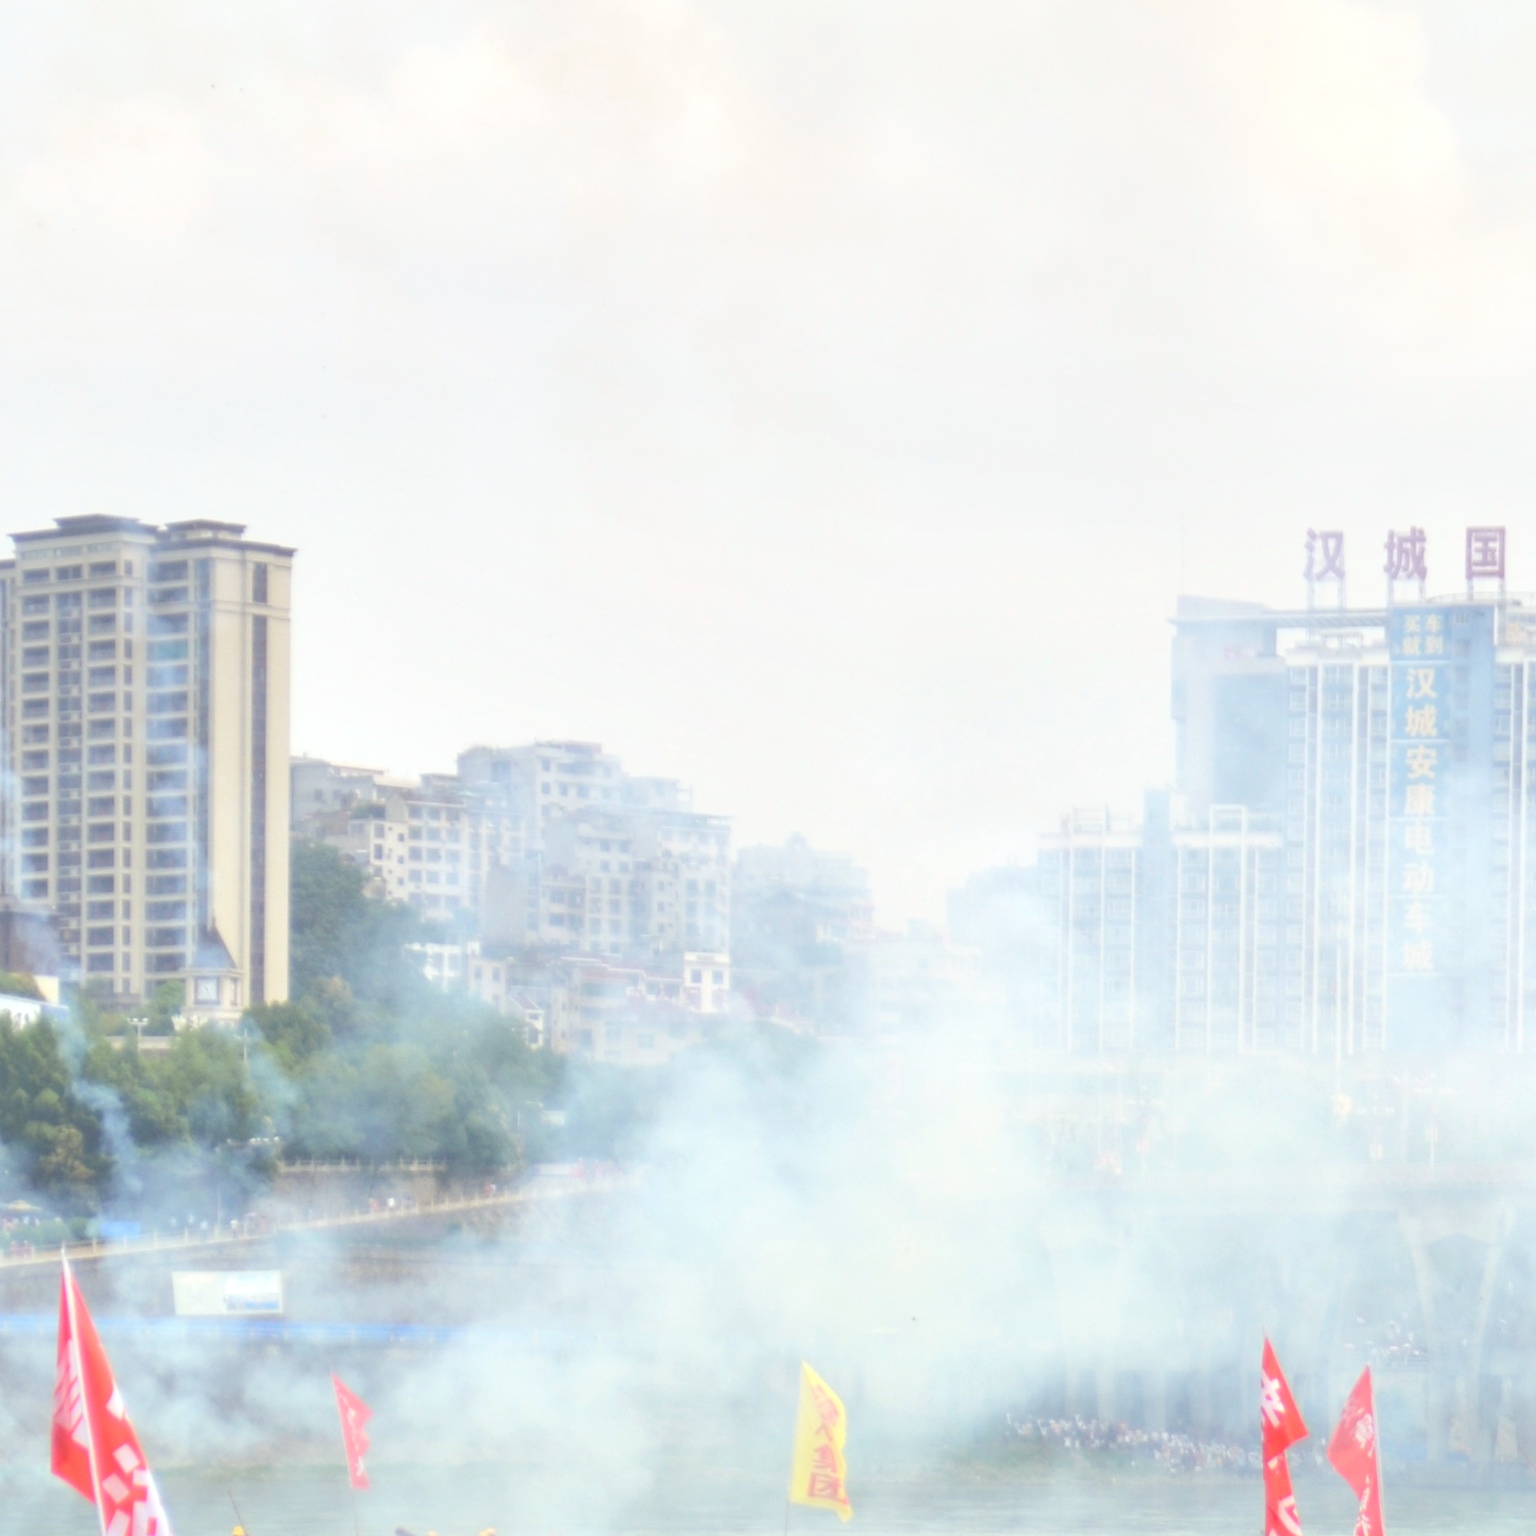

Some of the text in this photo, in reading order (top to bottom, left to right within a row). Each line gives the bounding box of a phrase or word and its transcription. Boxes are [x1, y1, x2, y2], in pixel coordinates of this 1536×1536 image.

[1404, 667, 1438, 972] 汉城安康电动车城
